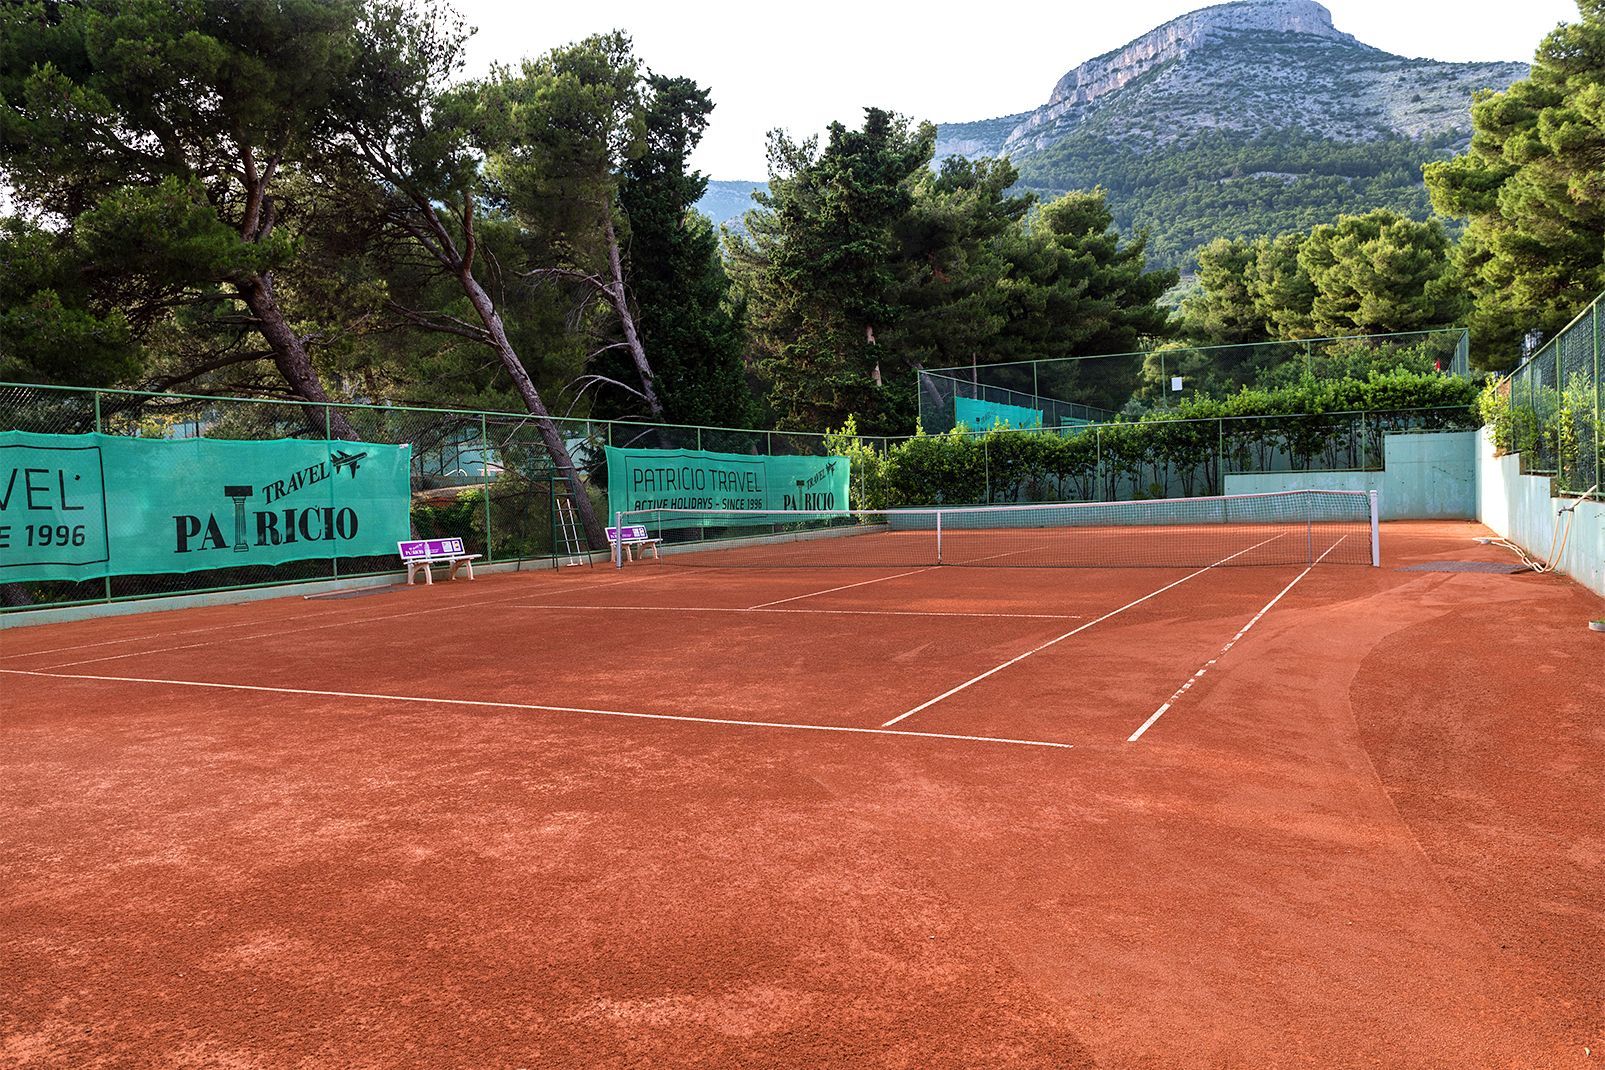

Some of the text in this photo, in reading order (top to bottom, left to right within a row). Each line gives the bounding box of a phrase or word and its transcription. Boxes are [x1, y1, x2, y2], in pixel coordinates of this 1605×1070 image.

[262, 461, 331, 505] TRAVEL
[633, 466, 762, 493] PATRICIO TRAVEL
[671, 497, 713, 510] HOLIDAYS
[722, 498, 744, 510] SINCE
[25, 524, 86, 547] 1996
